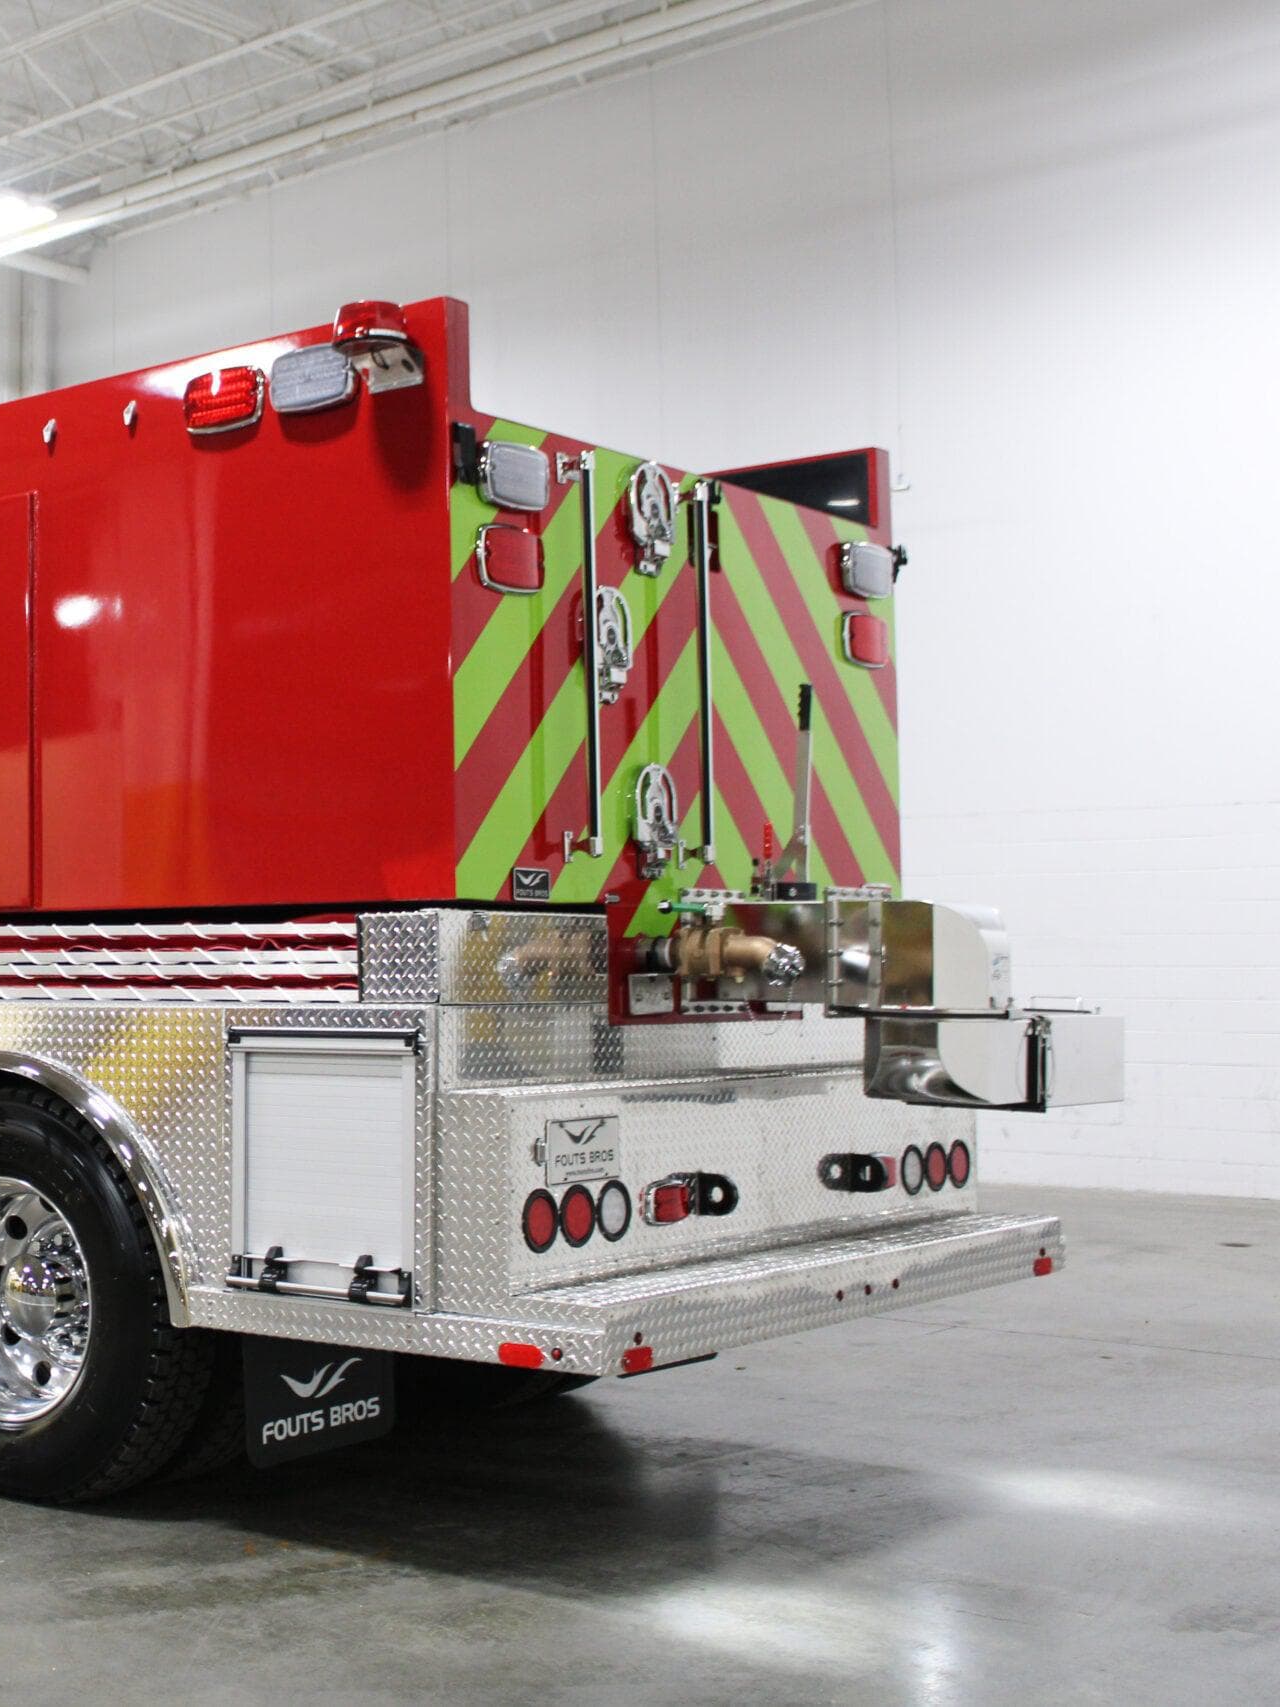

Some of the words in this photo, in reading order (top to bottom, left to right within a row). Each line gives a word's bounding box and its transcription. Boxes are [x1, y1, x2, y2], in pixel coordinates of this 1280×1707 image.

[554, 1151, 586, 1167] FOUTS
[589, 1149, 614, 1164] BROS
[262, 1409, 325, 1445] FOUTS
[329, 1396, 381, 1427] BROS
